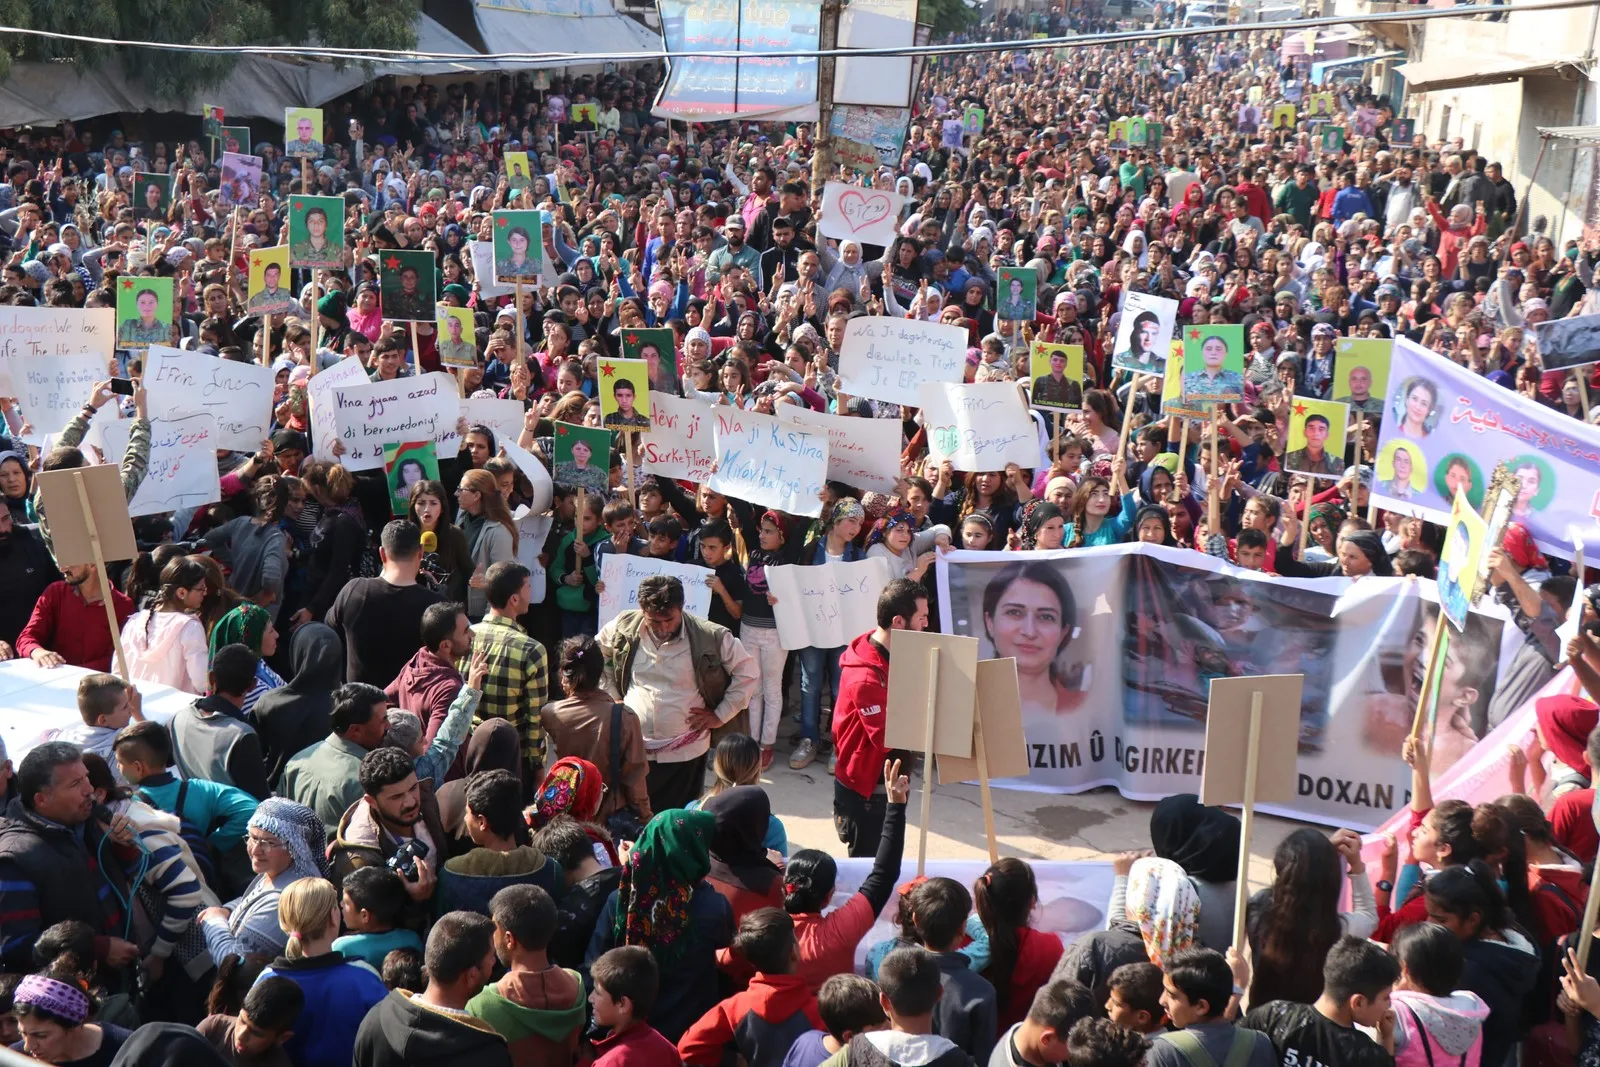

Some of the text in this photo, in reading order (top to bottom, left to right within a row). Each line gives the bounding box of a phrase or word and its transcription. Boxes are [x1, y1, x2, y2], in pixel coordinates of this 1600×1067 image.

[407, 378, 438, 400] azad
[344, 425, 356, 439] di
[1089, 729, 1105, 763] Û
